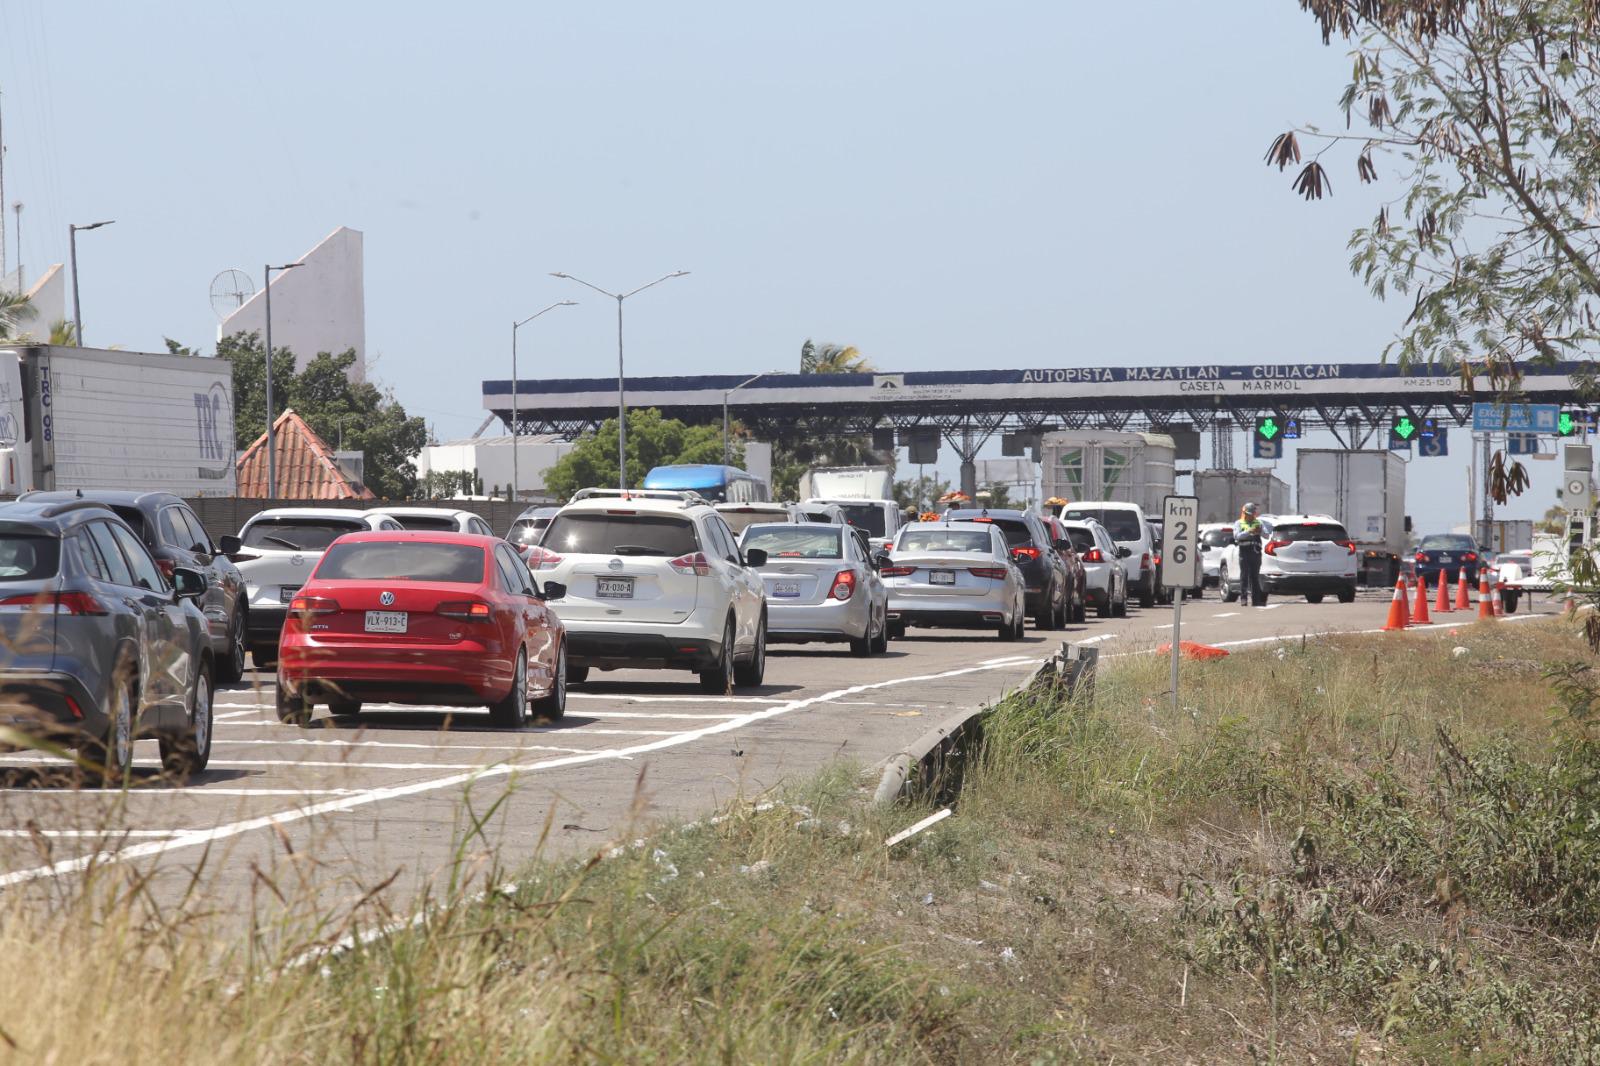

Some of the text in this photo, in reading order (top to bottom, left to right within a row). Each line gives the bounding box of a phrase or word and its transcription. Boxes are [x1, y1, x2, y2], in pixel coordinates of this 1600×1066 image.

[1022, 368, 1114, 382] AUTOPISTA
[1126, 366, 1219, 380] MAZATLAN
[1252, 364, 1340, 379] CULIACAN
[1180, 380, 1302, 392] CASETA MARMOL
[1404, 378, 1417, 386] KM
[40, 366, 51, 442] TRC 08
[193, 392, 224, 461] TRC
[1169, 502, 1193, 517] km
